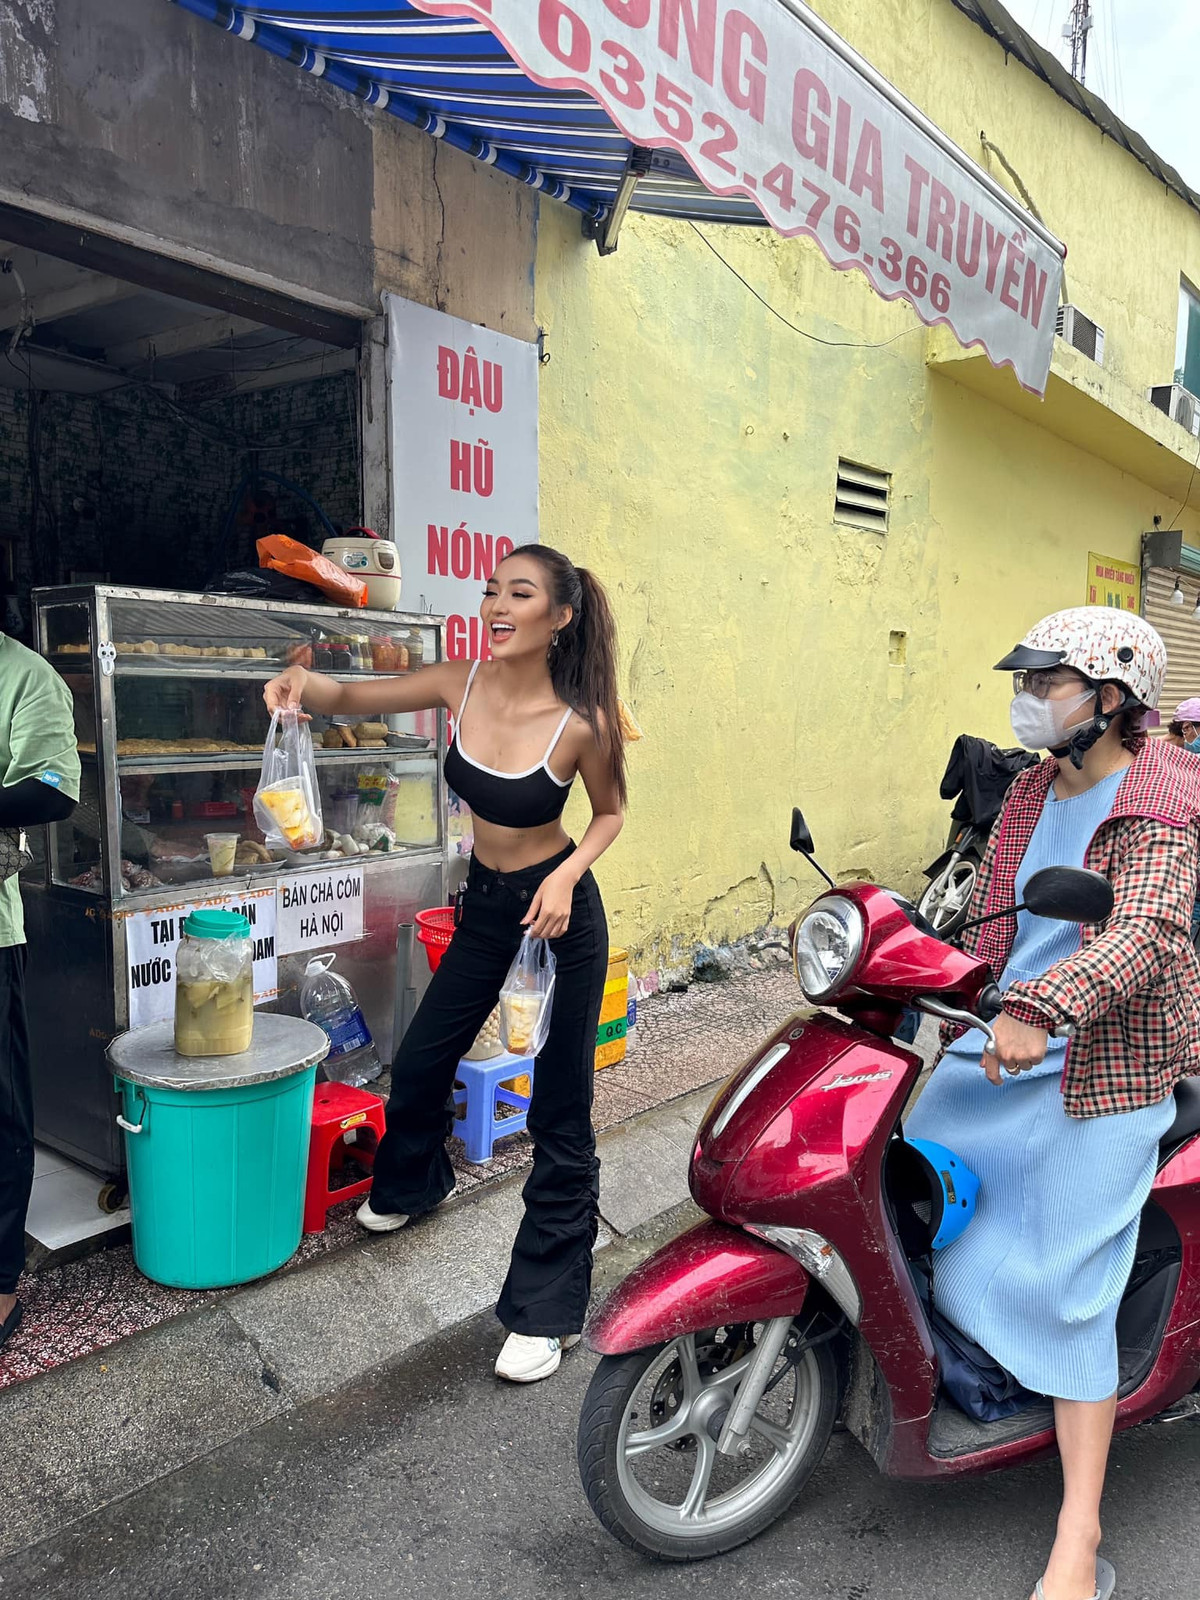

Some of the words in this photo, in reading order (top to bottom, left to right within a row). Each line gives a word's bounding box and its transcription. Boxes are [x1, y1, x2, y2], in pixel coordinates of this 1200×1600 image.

[602, 0, 767, 125] NG
[791, 68, 884, 214] GIA
[904, 153, 1047, 330] TRUYỀN
[437, 345, 503, 416] ĐẬU
[450, 438, 494, 498] HŨ
[282, 881, 308, 909] BÁN
[310, 876, 334, 904] CHẢ
[336, 873, 361, 900] CỐM
[150, 918, 175, 948] TẠI
[300, 912, 319, 939] HÀ
[322, 909, 344, 937] NỘI
[131, 957, 172, 989] NƯỚC
[252, 936, 275, 962] AM
